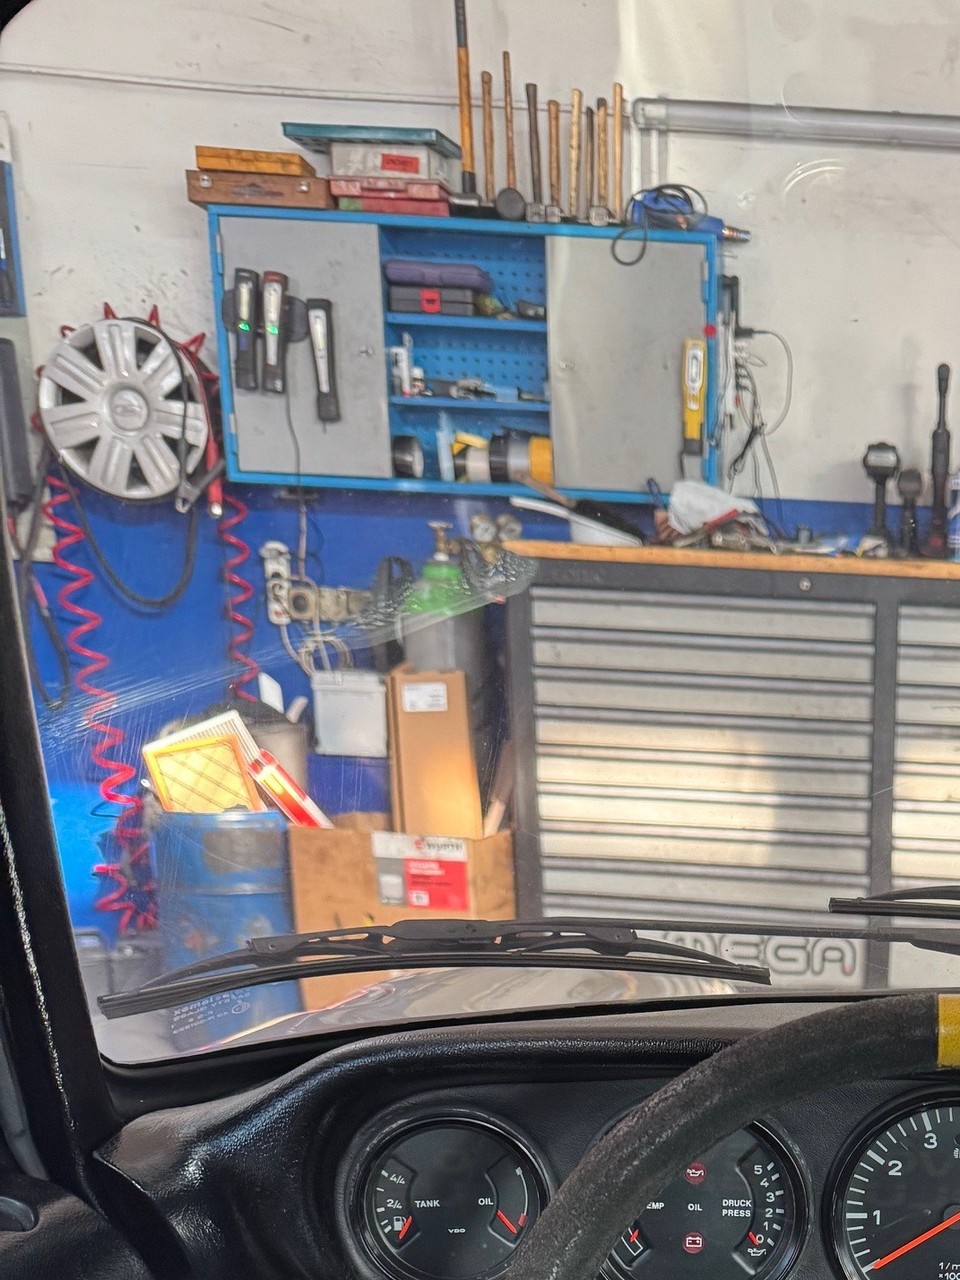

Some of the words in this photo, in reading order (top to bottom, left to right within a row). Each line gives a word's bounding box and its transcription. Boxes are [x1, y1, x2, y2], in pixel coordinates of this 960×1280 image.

[923, 1133, 938, 1149] 3
[754, 1164, 763, 1175] 5
[888, 1160, 903, 1176] 2
[389, 1173, 406, 1185] 4/4
[760, 1178, 770, 1188] 4
[478, 1197, 494, 1206] OIL
[766, 1192, 775, 1202] 3
[386, 1199, 403, 1209] 2/4
[415, 1199, 440, 1208] TANK
[646, 1202, 665, 1210] EMP
[688, 1203, 703, 1211] OIL
[722, 1199, 752, 1208] DRUCK
[722, 1209, 751, 1217] PRESS
[765, 1208, 773, 1218] 2
[873, 1209, 881, 1225] 1
[763, 1222, 769, 1231] 1
[755, 1233, 765, 1243] 0
